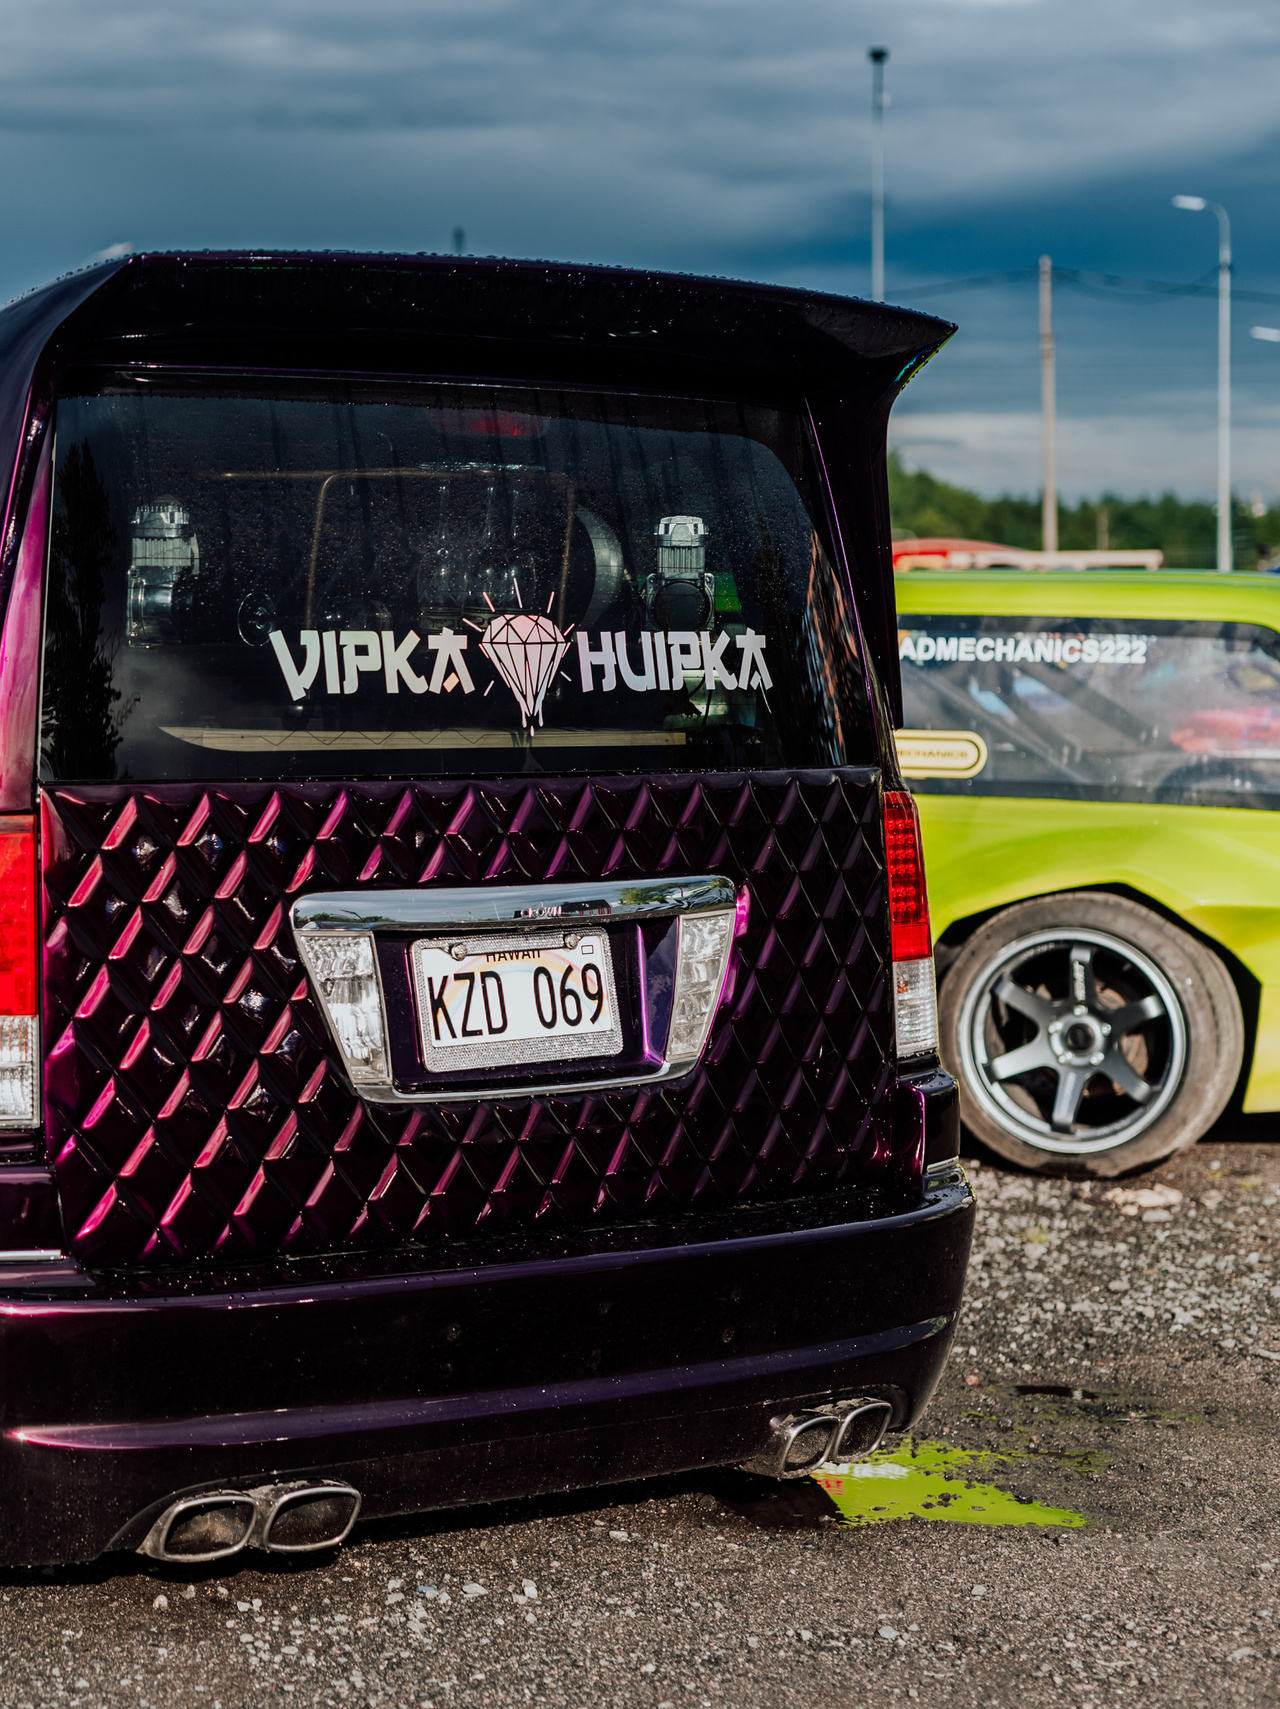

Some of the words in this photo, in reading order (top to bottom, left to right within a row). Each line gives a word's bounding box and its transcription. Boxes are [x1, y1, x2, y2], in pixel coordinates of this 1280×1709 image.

[269, 627, 475, 701] VIPKA
[577, 627, 774, 693] HUIPKA
[427, 970, 508, 1041] KZD
[533, 963, 603, 1029] 069
